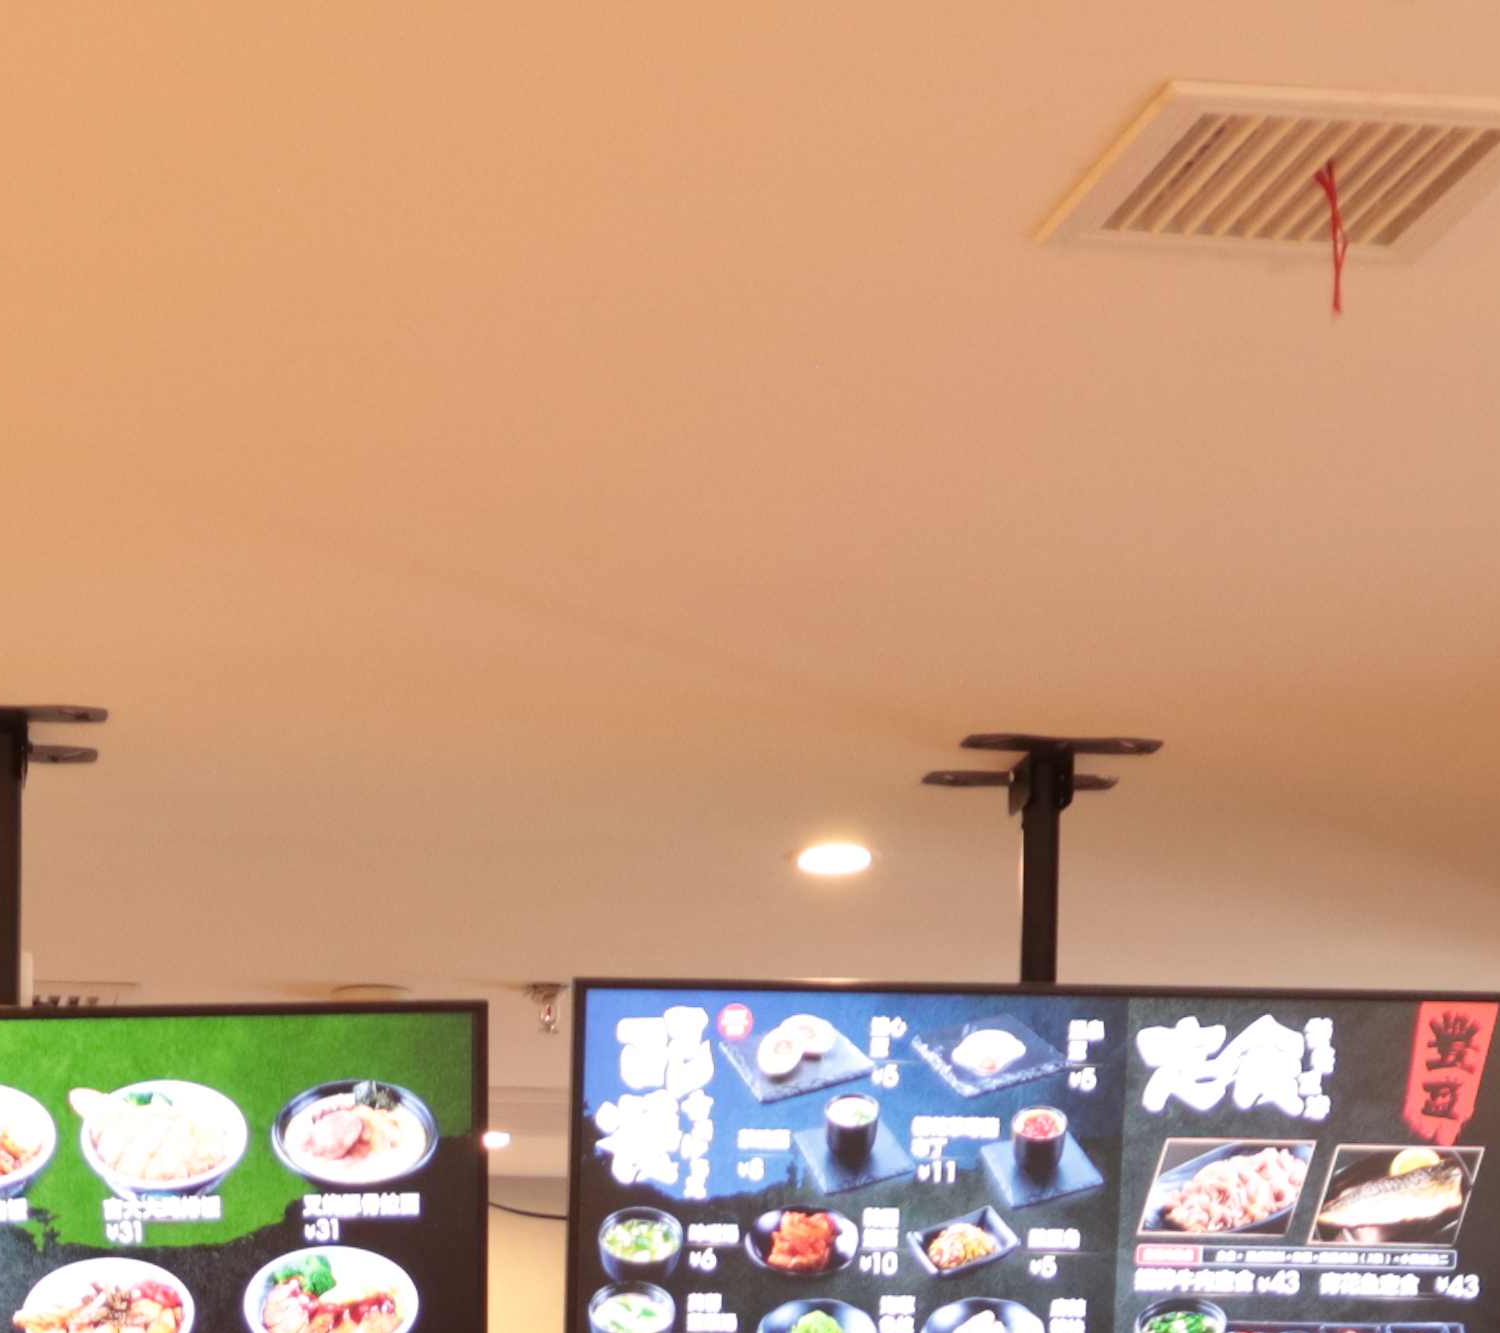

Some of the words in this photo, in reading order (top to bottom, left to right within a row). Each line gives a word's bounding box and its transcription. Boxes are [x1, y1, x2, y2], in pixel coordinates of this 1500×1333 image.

[918, 1159, 955, 1182] ¥11
[106, 1220, 142, 1244] ¥31
[305, 1218, 338, 1240] ¥31
[690, 1248, 716, 1270] ¥6
[860, 1251, 898, 1275] ¥10
[1030, 1255, 1056, 1278] ¥5
[1257, 1270, 1299, 1294] ¥43
[1436, 1275, 1479, 1298] ¥43
